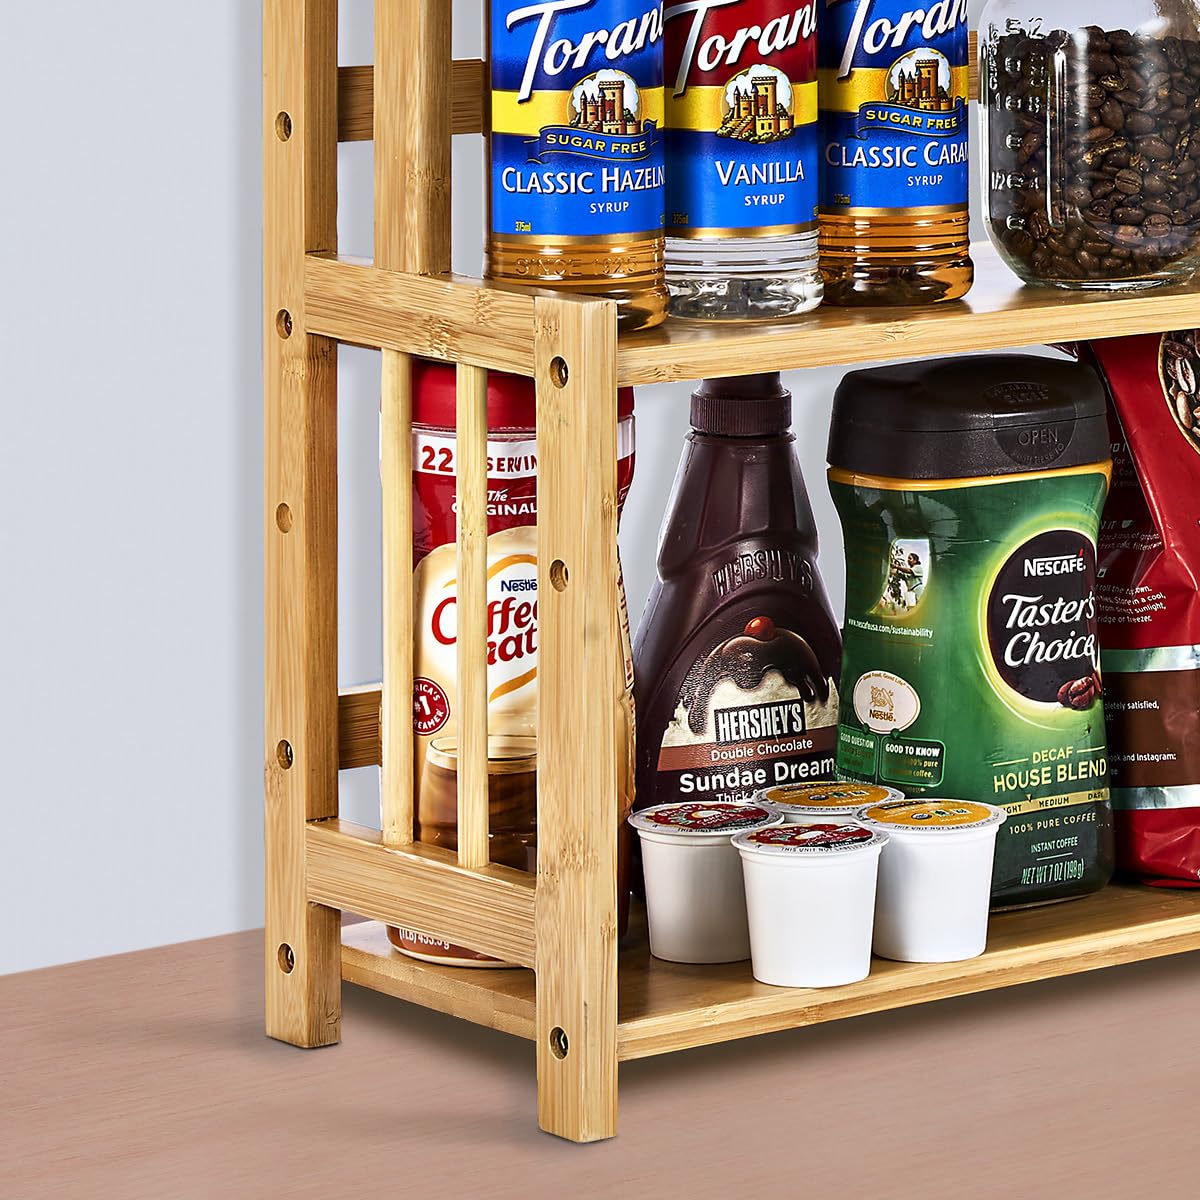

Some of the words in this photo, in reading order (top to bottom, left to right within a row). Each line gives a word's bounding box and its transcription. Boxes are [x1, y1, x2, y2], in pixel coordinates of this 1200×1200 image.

[866, 110, 922, 127] SUGAR
[926, 117, 958, 129] FREE
[546, 133, 606, 151] SUGAR
[611, 140, 646, 154] FREE
[825, 142, 917, 168] CLASSIC
[502, 167, 593, 194] CLASSIC
[602, 165, 665, 193] HAZELN
[714, 160, 805, 186] VANILLA
[907, 174, 943, 187] SYRUP
[590, 202, 630, 214] SYRUP
[744, 194, 785, 206] SYRUP
[1017, 428, 1058, 446] OPEN
[422, 445, 454, 472] 22
[488, 489, 509, 501] The
[1002, 591, 1095, 629] Taster's
[1004, 630, 1096, 668] Choice
[718, 702, 802, 742] HERSHEY'S
[711, 745, 754, 762] Double
[757, 738, 813, 756] Chocolate
[885, 743, 904, 754] GOOD
[904, 745, 915, 755] TO
[915, 747, 941, 757] KNOW
[1032, 746, 1074, 764] DECAF
[1136, 753, 1177, 762] Instagram:
[923, 760, 939, 768] pure
[679, 766, 767, 793] Sundae
[774, 757, 835, 782] Dream
[993, 766, 1052, 793] HOUSE
[1057, 758, 1107, 783] BLEND
[716, 791, 749, 803] Thick
[1039, 796, 1070, 808] MEDIUM
[1009, 823, 1033, 835] 100%
[1037, 817, 1060, 830] PURE
[1063, 812, 1096, 825] COFFEE
[1031, 840, 1055, 853] INSTANT
[1056, 836, 1078, 849] COFFEE
[1021, 867, 1035, 885] NET
[1036, 864, 1048, 884] WT
[1048, 863, 1054, 883] 7
[1054, 861, 1064, 882] OZ
